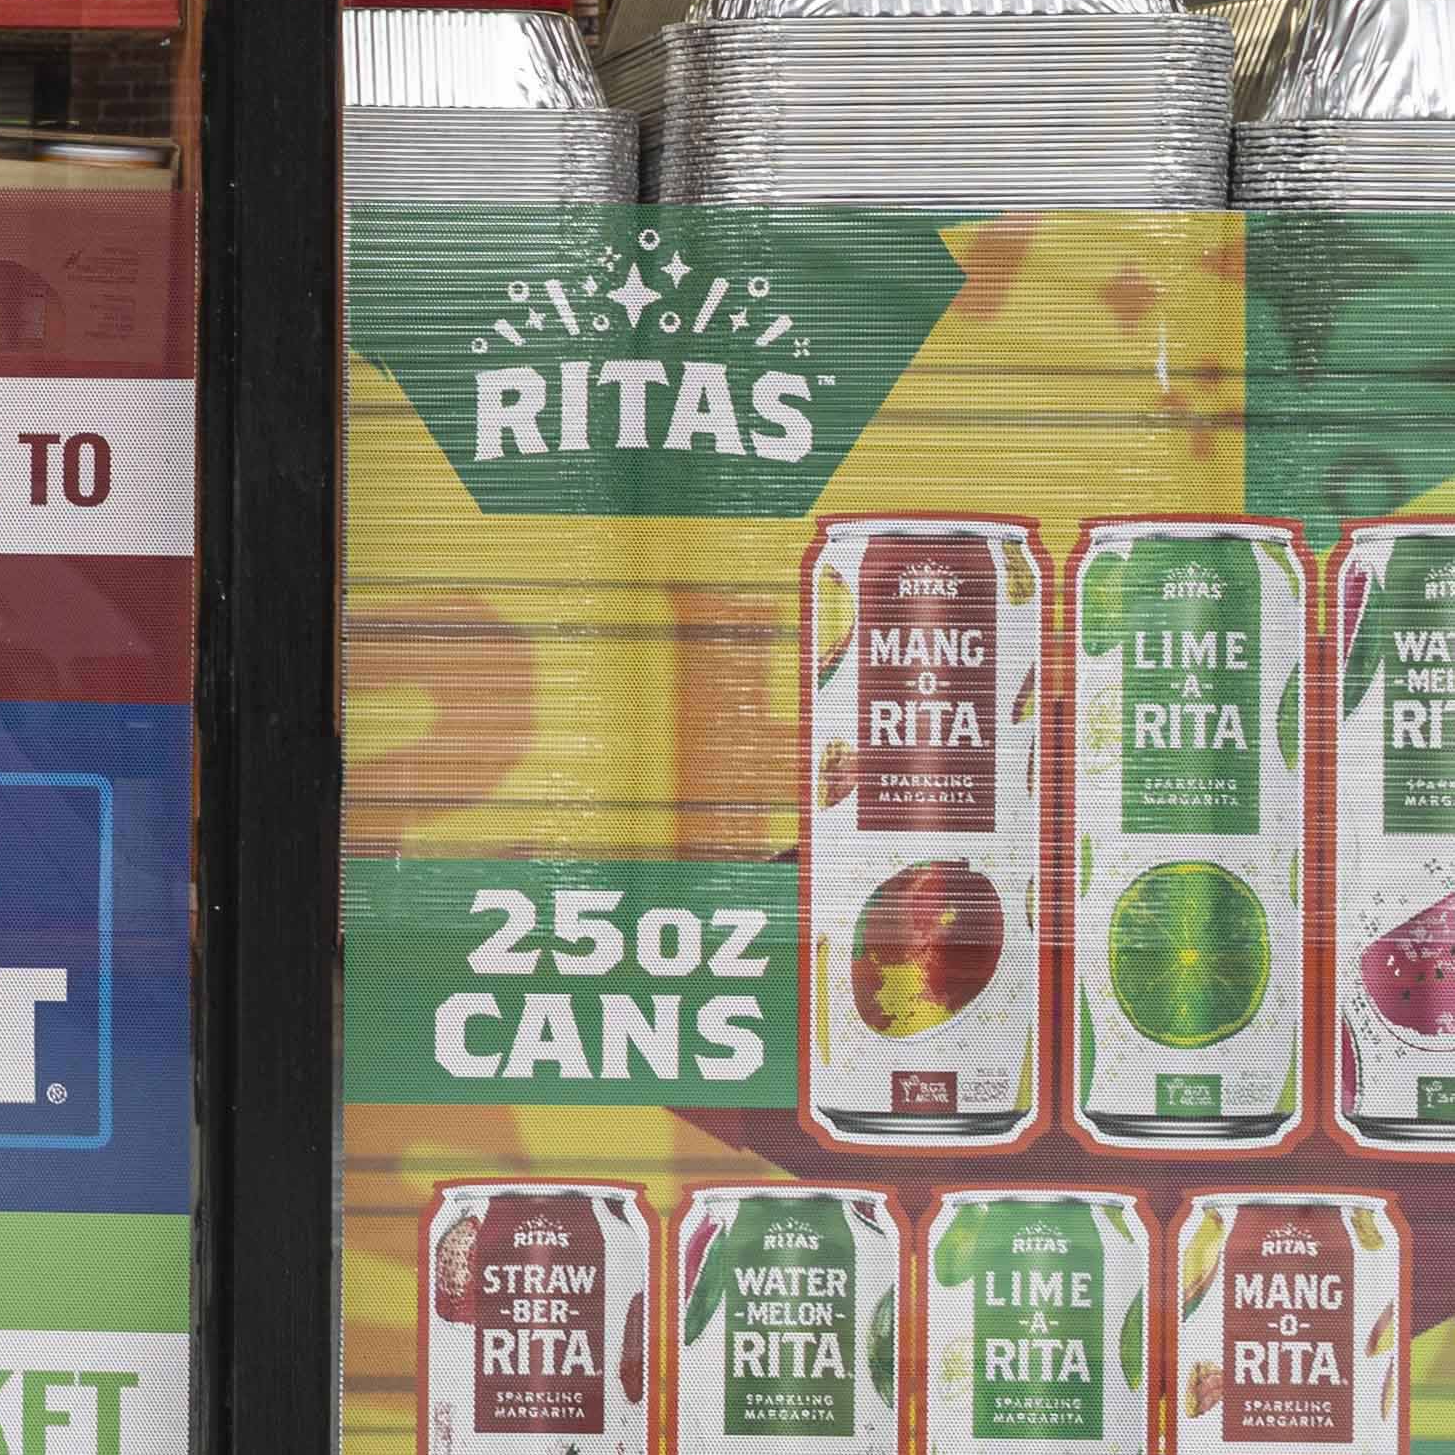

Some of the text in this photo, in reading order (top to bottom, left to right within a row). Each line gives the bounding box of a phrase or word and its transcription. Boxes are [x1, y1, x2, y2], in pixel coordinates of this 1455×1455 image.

[473, 359, 814, 464] RITAS
[19, 430, 112, 507] TO
[869, 627, 985, 670] MANG
[1134, 629, 1248, 671] LIME
[869, 700, 984, 748] RITA
[1134, 702, 1248, 751] RITA
[880, 776, 974, 789] SPARKLING
[1144, 778, 1238, 791] SPARKLING
[434, 992, 767, 1081] CANS
[512, 1229, 570, 1249] RITAS
[763, 1231, 820, 1251] RITAS
[482, 1263, 597, 1295] STRAW
[734, 1266, 848, 1298] WATER
[984, 1270, 1093, 1308] LIME
[1233, 1273, 1344, 1311] MANG
[482, 1328, 596, 1378] RITA
[732, 1330, 848, 1380] RITA
[984, 1338, 1092, 1384] RITA
[1233, 1340, 1346, 1386] RITA
[495, 1391, 584, 1405] SPARKLING
[745, 1393, 835, 1407] SPARKLING
[994, 1397, 1082, 1410] SPARKLING
[1242, 1399, 1332, 1413] SPARKLING
